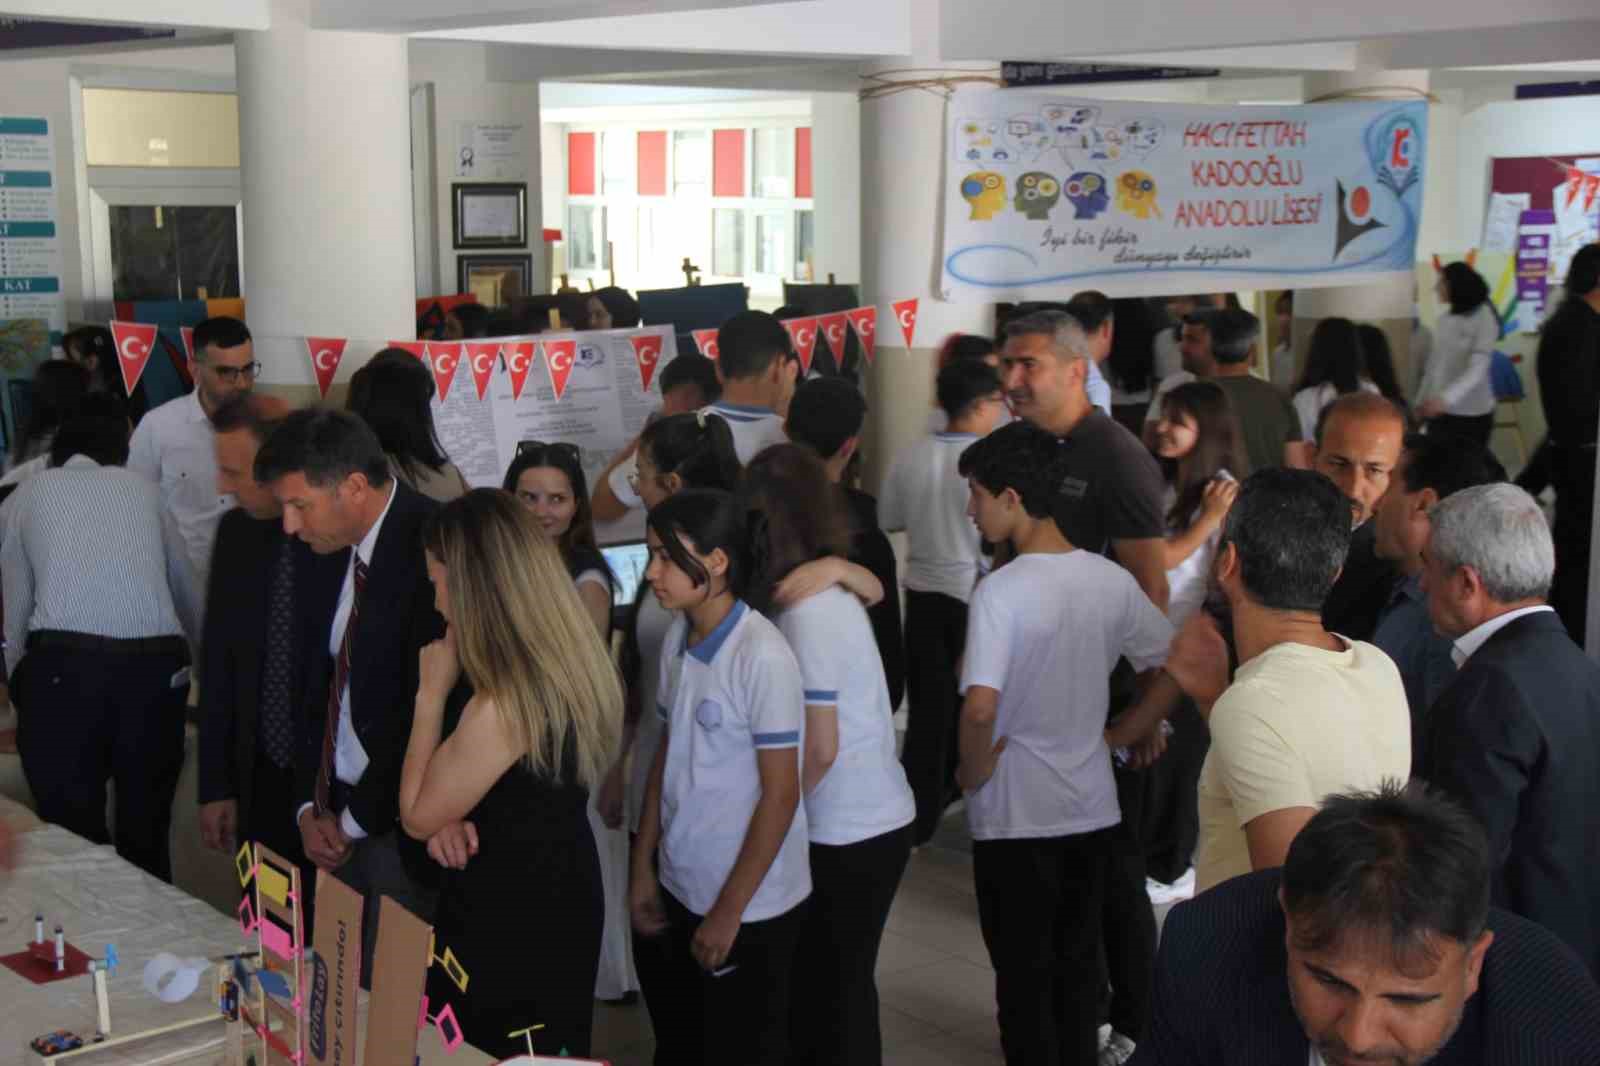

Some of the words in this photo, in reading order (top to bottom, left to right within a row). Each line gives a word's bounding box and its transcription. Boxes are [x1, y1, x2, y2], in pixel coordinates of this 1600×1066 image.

[1234, 120, 1308, 148] FETTAH
[1191, 154, 1304, 187] KADOOĞLU
[1174, 199, 1269, 227] ANADOLU
[1271, 192, 1323, 226] LİSESİ
[1071, 226, 1095, 246] bir
[1098, 226, 1139, 251] fikir
[4, 278, 33, 292] KAT
